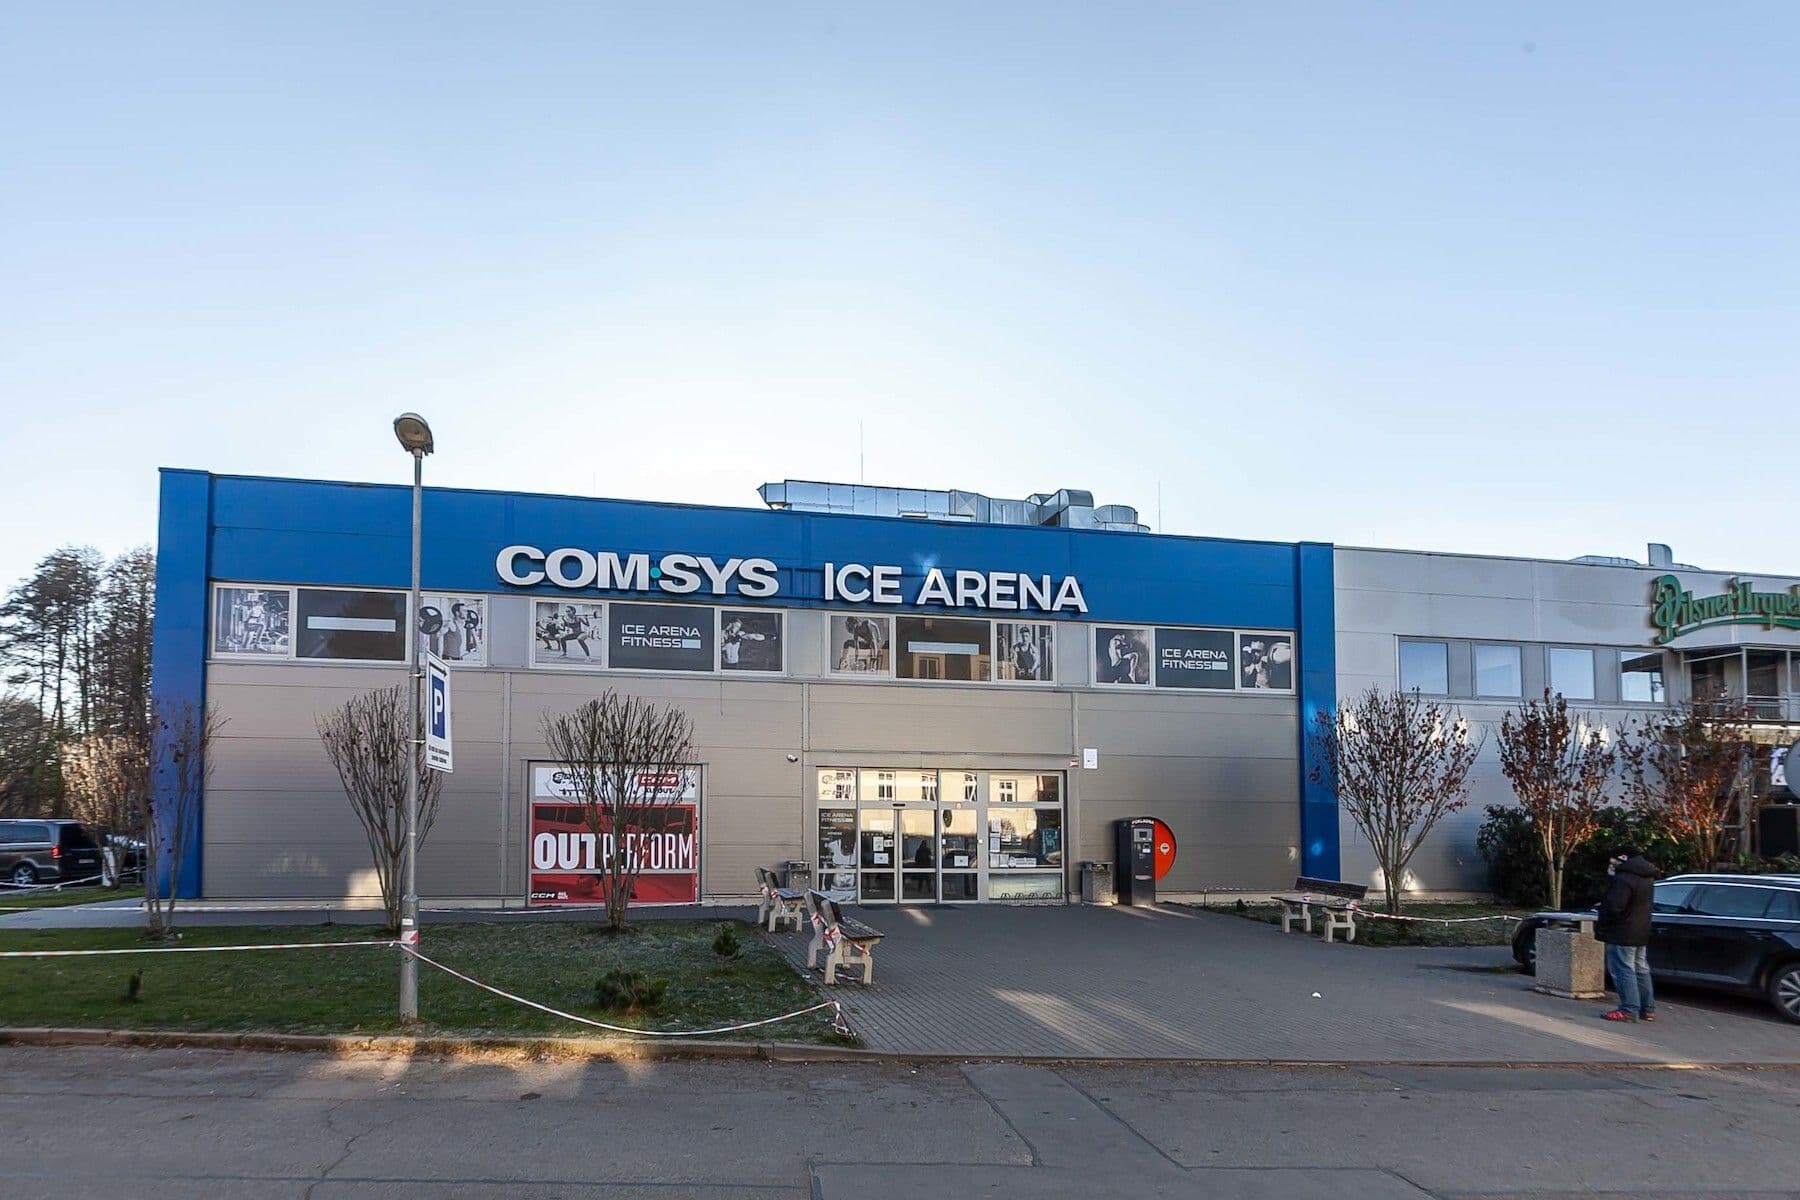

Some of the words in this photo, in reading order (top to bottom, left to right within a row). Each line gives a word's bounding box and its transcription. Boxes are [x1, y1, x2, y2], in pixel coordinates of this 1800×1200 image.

[824, 562, 903, 604] ICE
[916, 568, 1089, 613] ARENA
[1654, 574, 1738, 645] Pilsner
[621, 624, 645, 635] ICE
[648, 625, 701, 637] ARENA
[621, 636, 682, 648] FITNESS
[1162, 648, 1182, 658] ICE
[1184, 649, 1228, 660] ARENA
[1162, 659, 1212, 670] FITNESS
[434, 687, 443, 725] P
